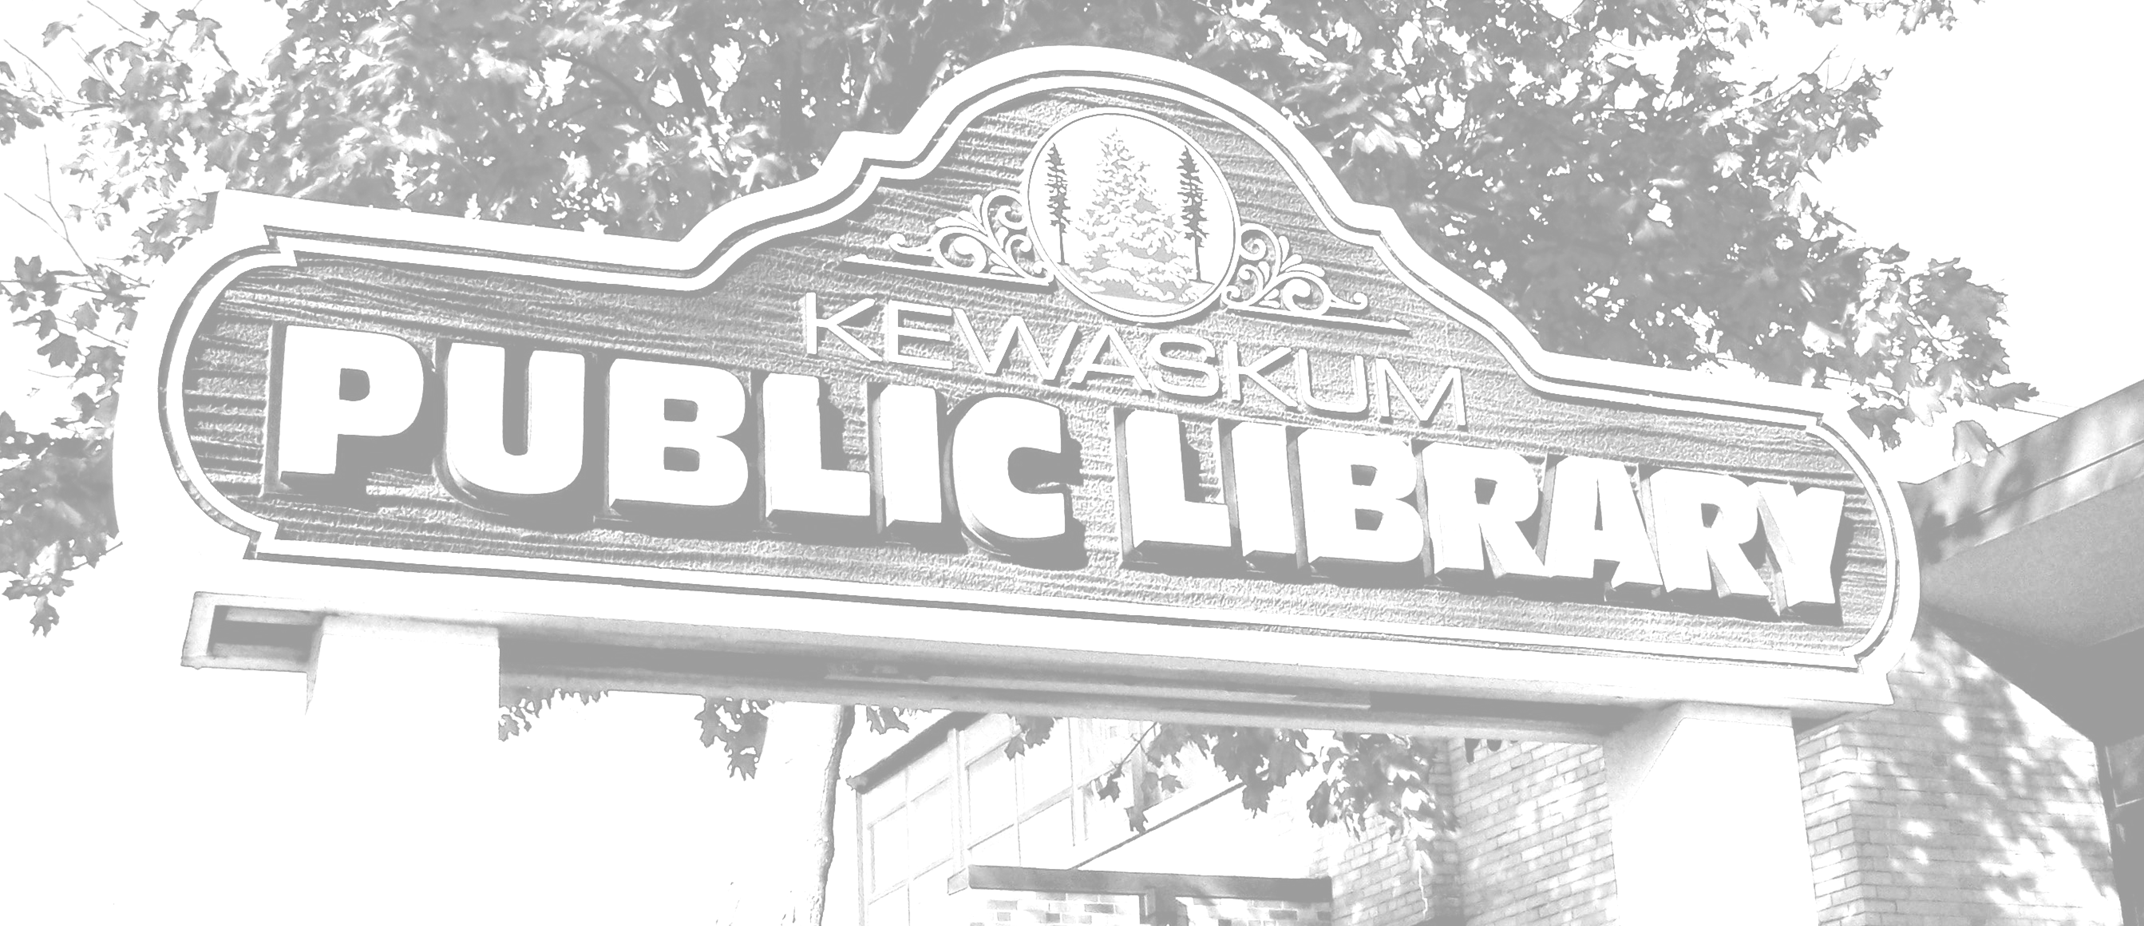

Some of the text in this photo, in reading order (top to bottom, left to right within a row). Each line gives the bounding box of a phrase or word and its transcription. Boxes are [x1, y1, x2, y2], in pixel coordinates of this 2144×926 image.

[804, 291, 1470, 427] KEWASKUM
[276, 324, 1846, 608] PUBLIC LIBRARY
